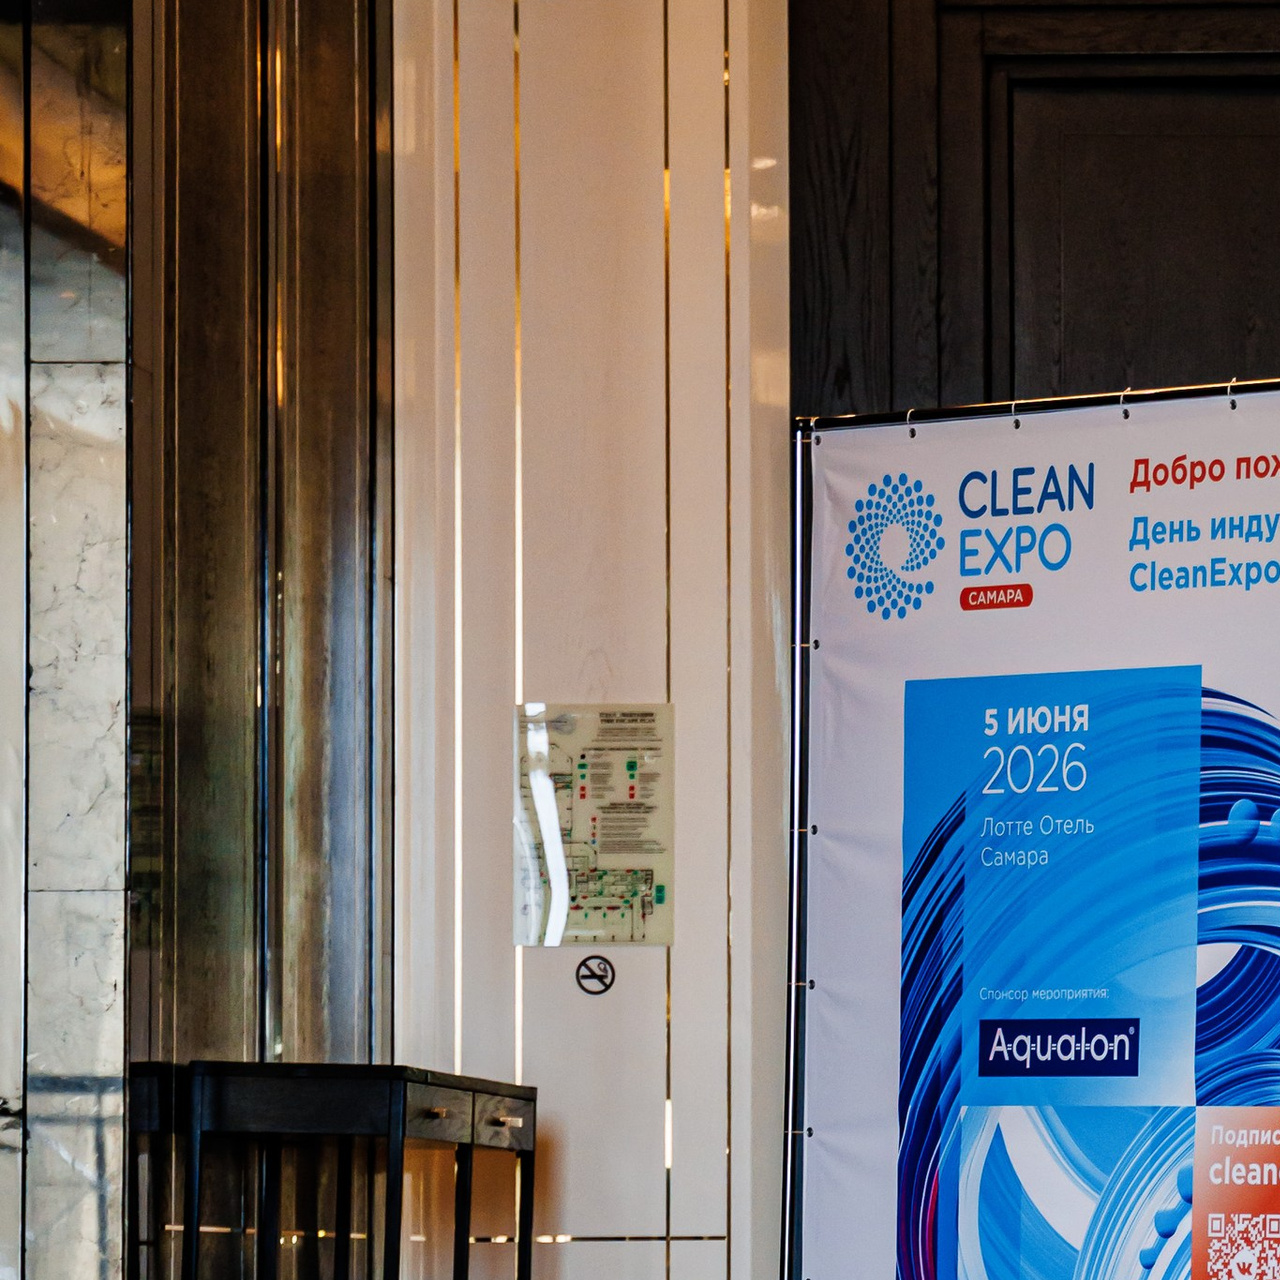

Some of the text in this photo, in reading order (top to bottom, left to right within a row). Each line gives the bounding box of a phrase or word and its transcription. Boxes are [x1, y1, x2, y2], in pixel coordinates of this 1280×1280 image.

[958, 462, 1095, 519] CLEAN
[1130, 454, 1225, 493] Добро
[959, 523, 1072, 577] EXPO
[1129, 516, 1201, 551] День
[968, 588, 1024, 606] САМАРА
[983, 703, 1089, 737] 5 ИЮНЯ
[981, 742, 1087, 795] 2026
[980, 815, 1095, 838] Лотте Отель
[980, 846, 1049, 869] Самара
[979, 987, 1111, 1001] Спонсор мероприятия:
